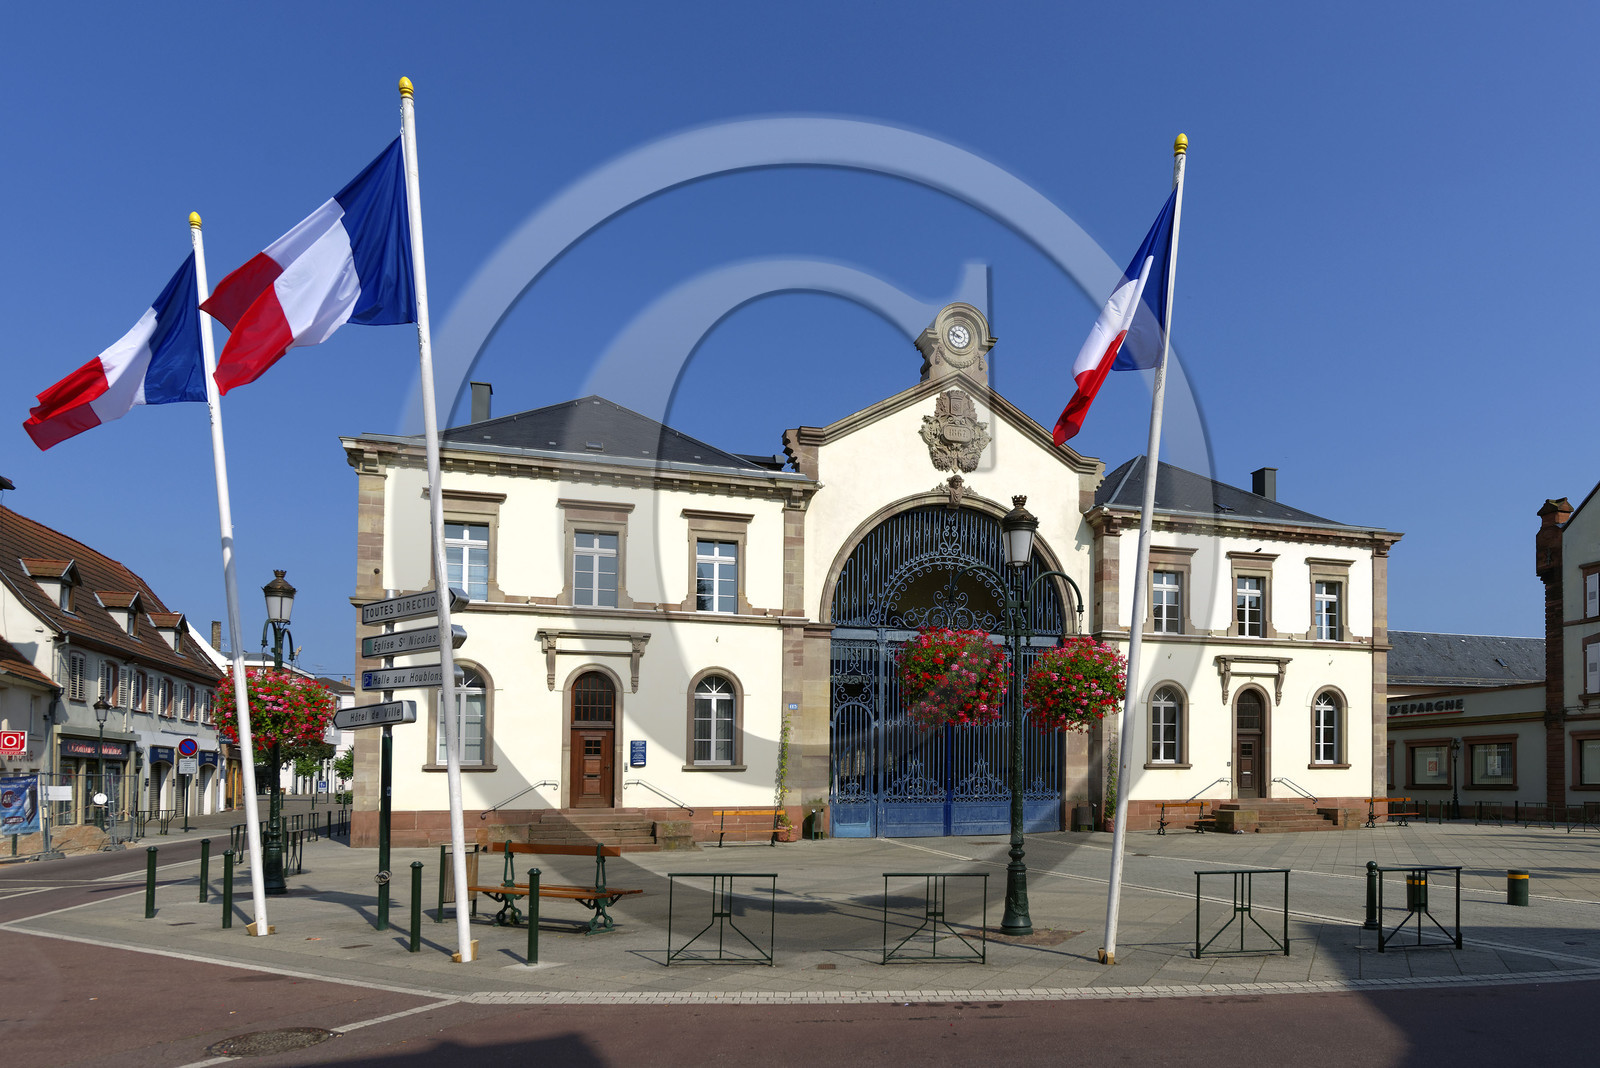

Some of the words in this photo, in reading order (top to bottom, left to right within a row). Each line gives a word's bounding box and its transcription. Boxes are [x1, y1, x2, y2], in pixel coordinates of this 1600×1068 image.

[365, 604, 394, 619] TOUTES
[397, 597, 436, 613] DIRECTIO
[373, 639, 394, 653] Église
[408, 634, 437, 646] Nicolas
[372, 673, 390, 685] Halle
[393, 675, 406, 683] aux
[409, 670, 443, 683] Houblons
[350, 711, 368, 723] Hôtel
[371, 710, 380, 719] de
[384, 706, 401, 718] Ville
[1389, 699, 1464, 715] D'EPARGNE
